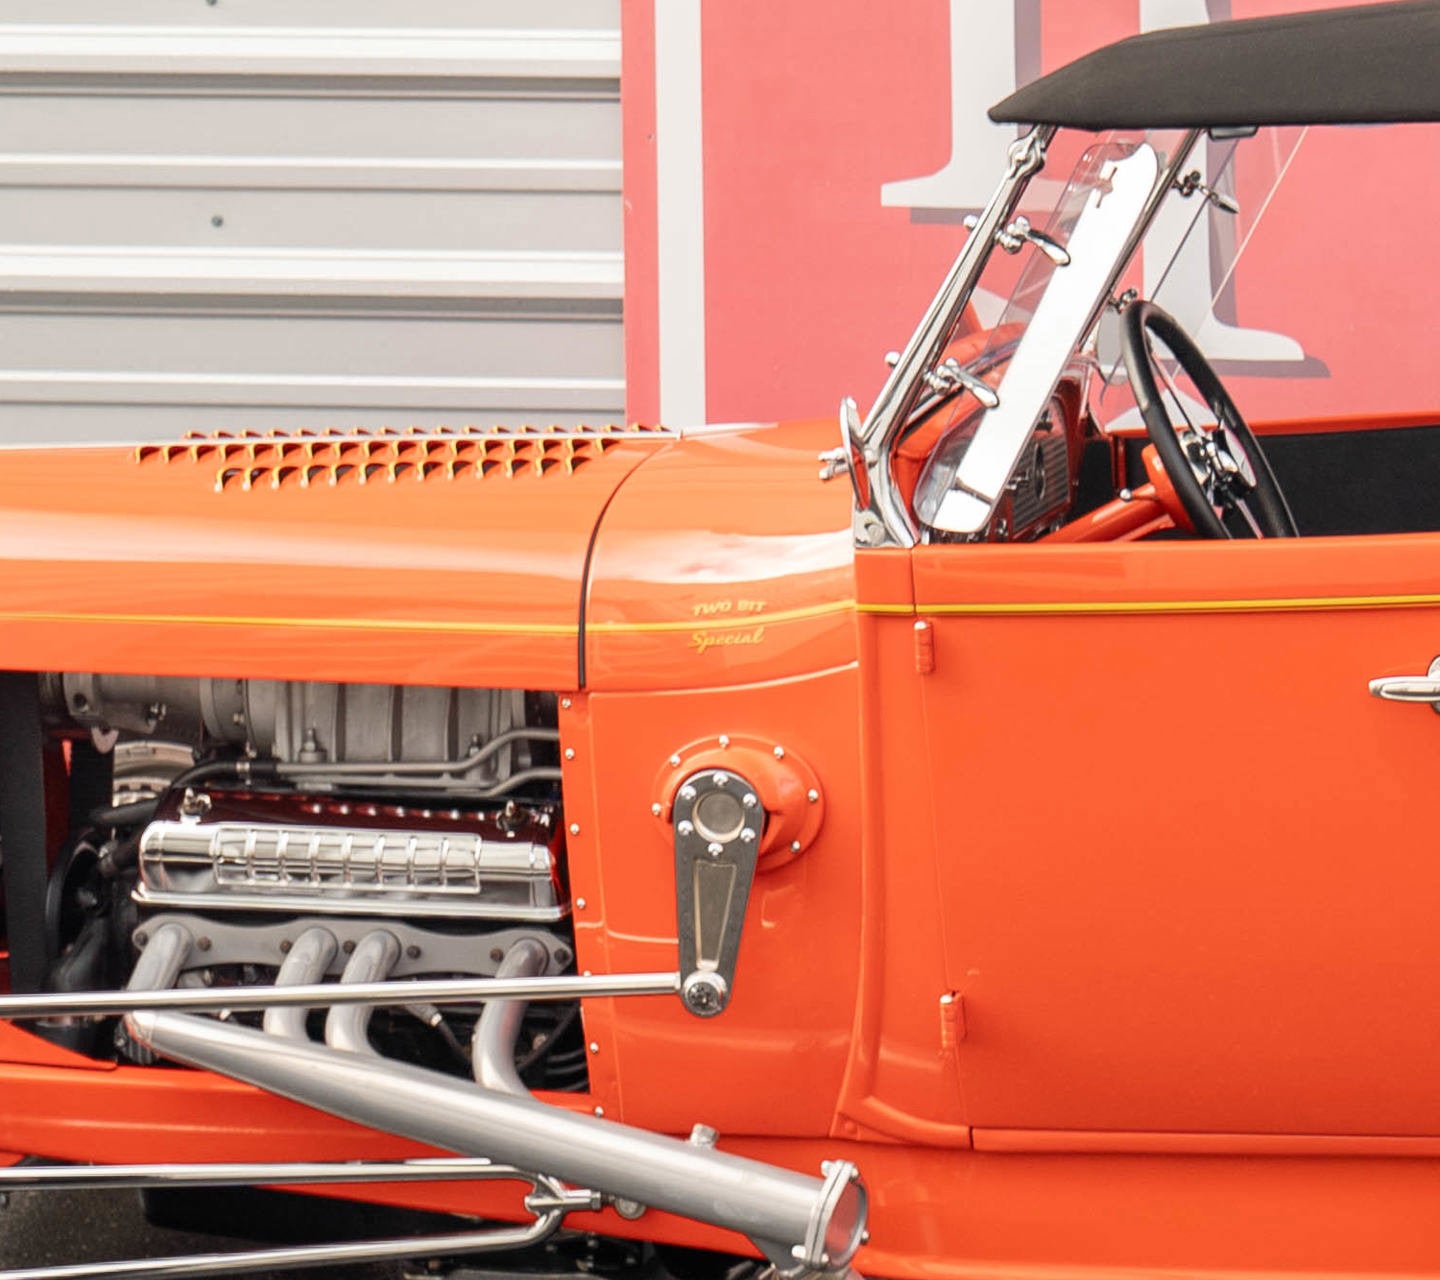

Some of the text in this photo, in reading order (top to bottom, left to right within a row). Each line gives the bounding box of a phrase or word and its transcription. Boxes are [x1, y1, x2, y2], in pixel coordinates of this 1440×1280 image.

[693, 600, 766, 615] TWO BIT
[688, 626, 764, 653] Special
